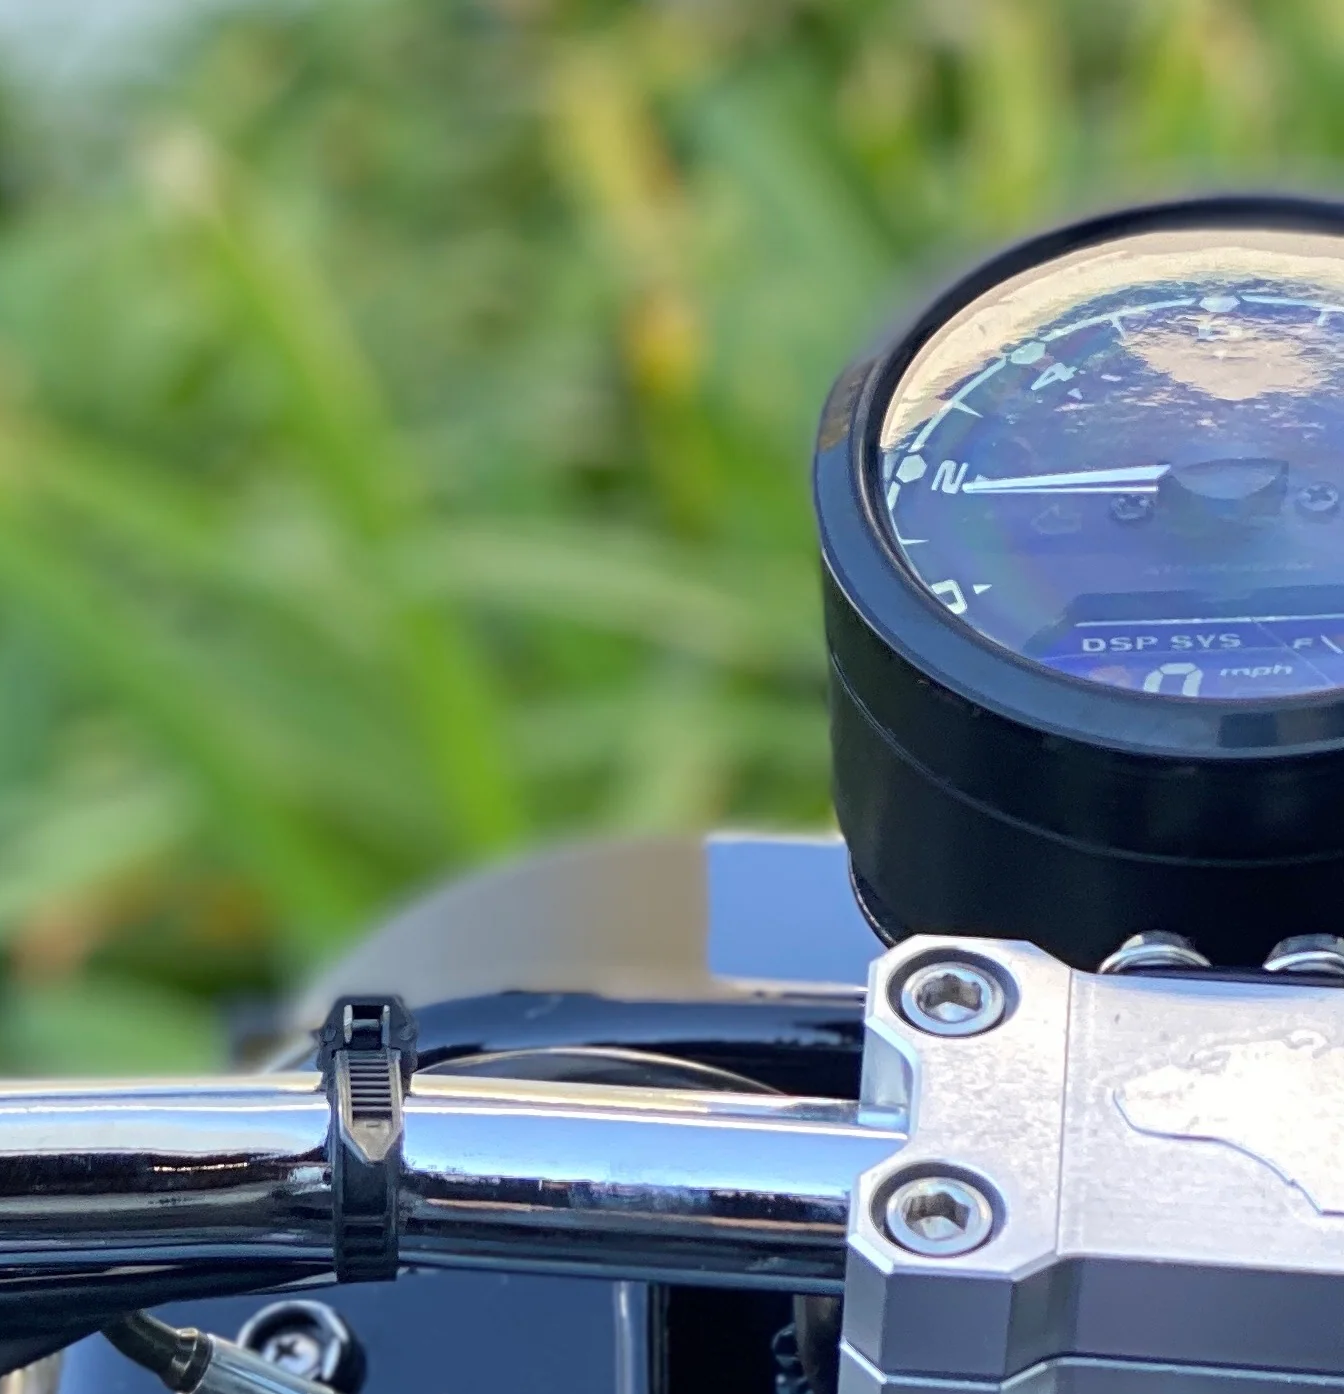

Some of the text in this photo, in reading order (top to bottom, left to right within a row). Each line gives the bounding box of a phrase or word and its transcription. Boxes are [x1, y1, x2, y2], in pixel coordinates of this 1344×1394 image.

[1081, 633, 1242, 653] DSP SYS
[1219, 664, 1294, 679] mph
